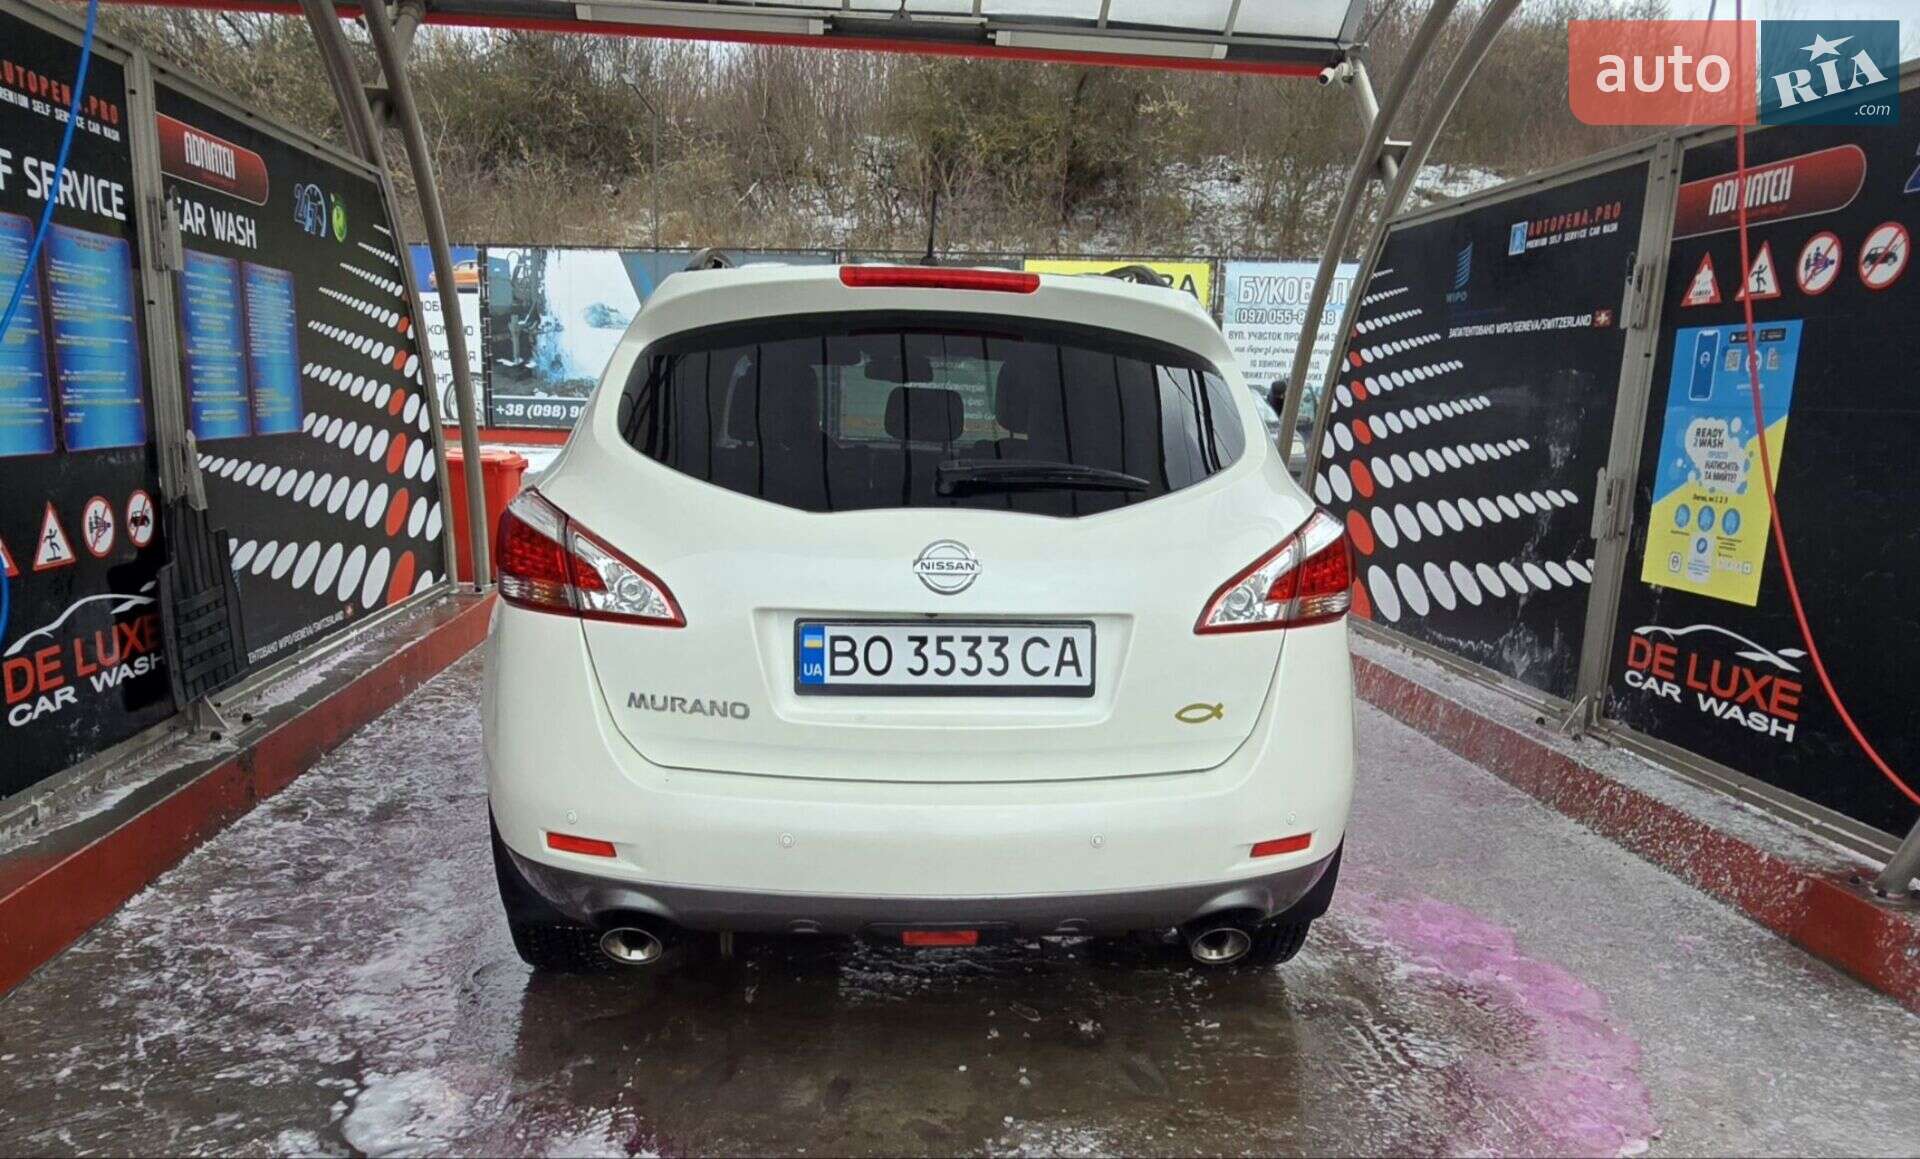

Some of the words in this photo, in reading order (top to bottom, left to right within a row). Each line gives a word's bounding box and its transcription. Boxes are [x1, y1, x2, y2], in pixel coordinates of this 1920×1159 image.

[0, 59, 119, 125] UTOPEN.PRO
[54, 108, 85, 130] SERCE
[23, 155, 127, 222] SERVICE
[177, 197, 207, 237] AR
[210, 206, 258, 250] WASH
[1238, 275, 1356, 306] БУКОВЛ
[1235, 307, 1267, 325] (097)
[496, 403, 525, 417] +38
[526, 403, 567, 420] (098)
[1695, 427, 1725, 438] READY
[920, 560, 976, 572] NISSAN
[3, 645, 65, 705] DE
[803, 665, 823, 677] UA
[829, 634, 893, 677] BO
[906, 635, 1010, 677] 3533
[1021, 635, 1084, 678] CA
[1627, 634, 1679, 681] DE
[1686, 652, 1803, 722] LUXE
[8, 686, 78, 727] CAR
[626, 691, 751, 721] MURANO
[1624, 669, 1682, 704] CAR
[1697, 692, 1796, 743] WASH
